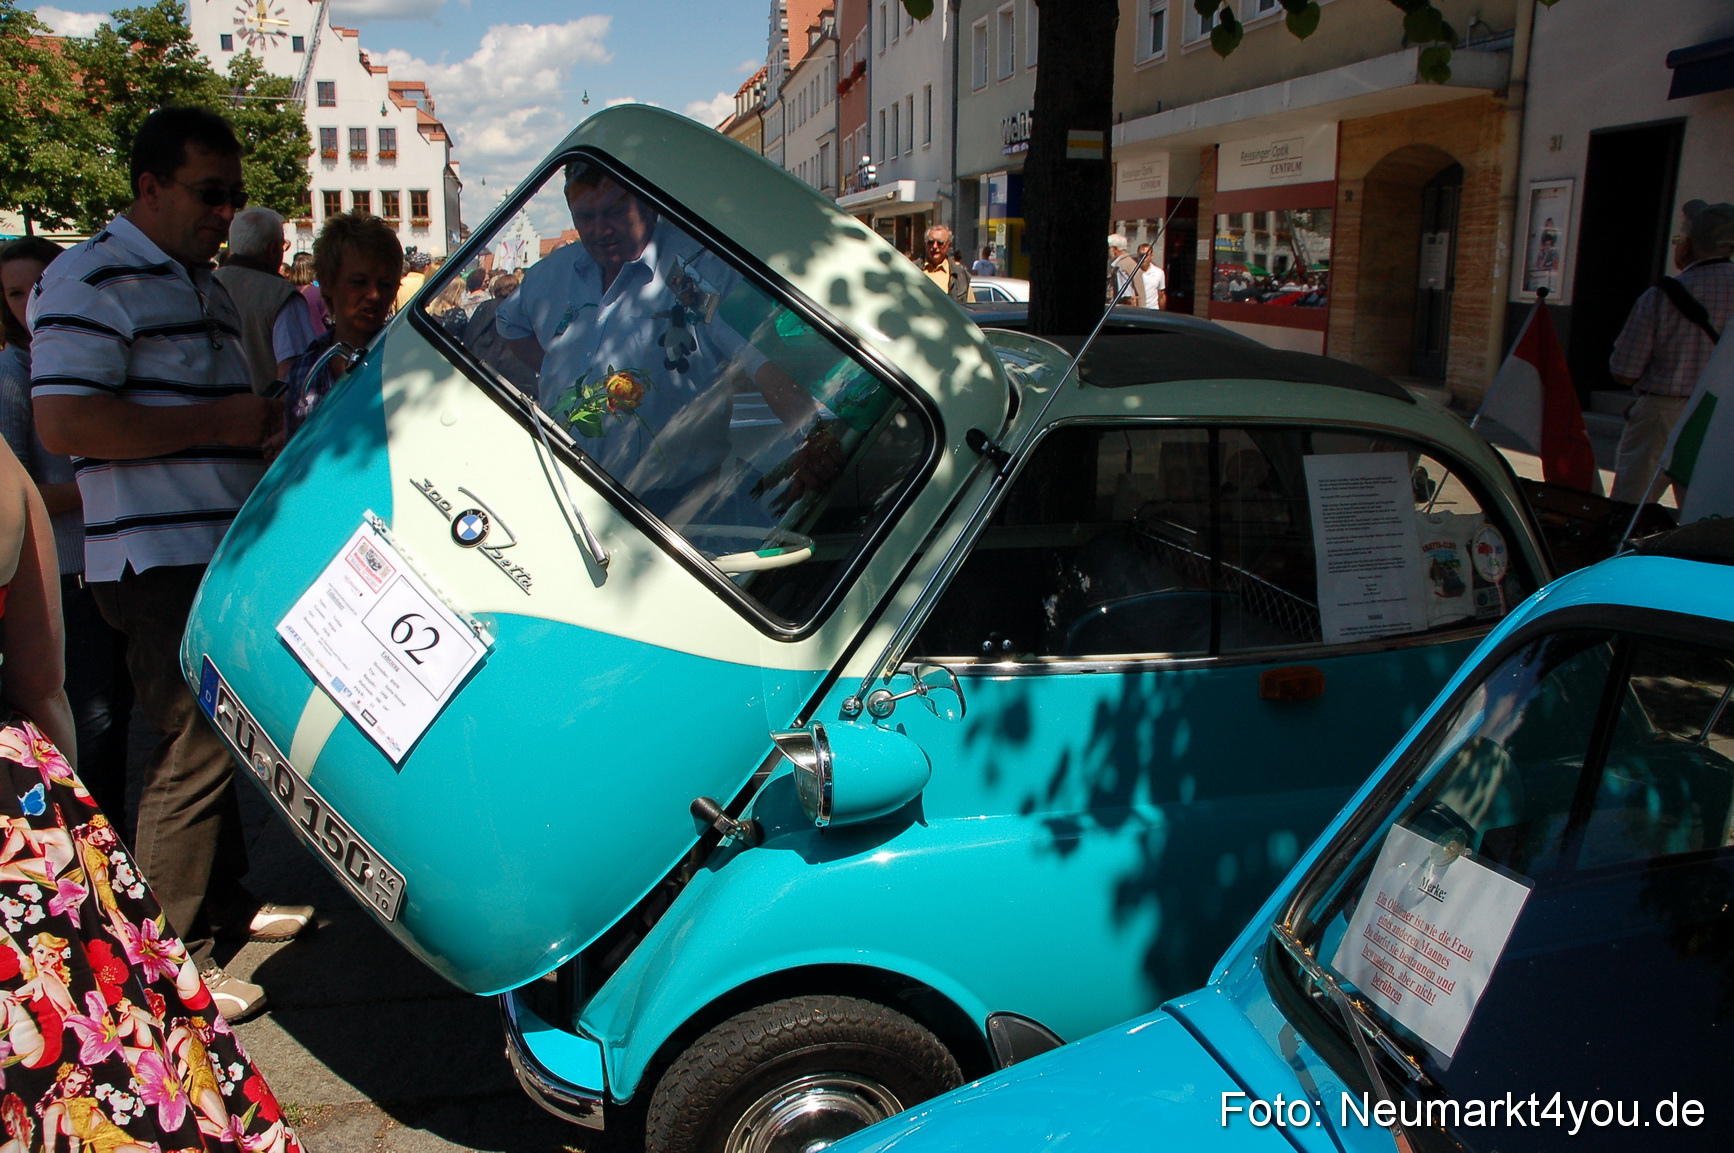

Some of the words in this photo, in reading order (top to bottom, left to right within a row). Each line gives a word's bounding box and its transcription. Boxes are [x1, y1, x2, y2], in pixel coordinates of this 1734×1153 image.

[1272, 144, 1289, 157] Optik
[1270, 161, 1302, 175] CENTRUM
[466, 510, 489, 532] BMW
[391, 613, 440, 665] 62
[217, 684, 258, 760] FÜ
[274, 760, 296, 811] Q
[300, 796, 371, 885] 150
[1420, 877, 1447, 901] Merke:
[1376, 891, 1388, 906] Ein
[1387, 898, 1415, 922] Oldtimer
[1414, 915, 1424, 929] ist
[1424, 921, 1438, 937] wie
[1438, 930, 1451, 946] die
[1451, 936, 1474, 959] Frau
[1378, 914, 1392, 931] eines
[1392, 923, 1420, 948] anderen
[1420, 939, 1451, 967] Mannes
[1364, 923, 1373, 936] Du
[1373, 929, 1391, 947] darfst
[1390, 941, 1399, 956] sie
[1398, 946, 1436, 980] bestaunen
[1437, 972, 1456, 993] und
[1372, 971, 1403, 1003] berühren
[1397, 971, 1415, 988] aber
[1415, 981, 1438, 1003] nicht
